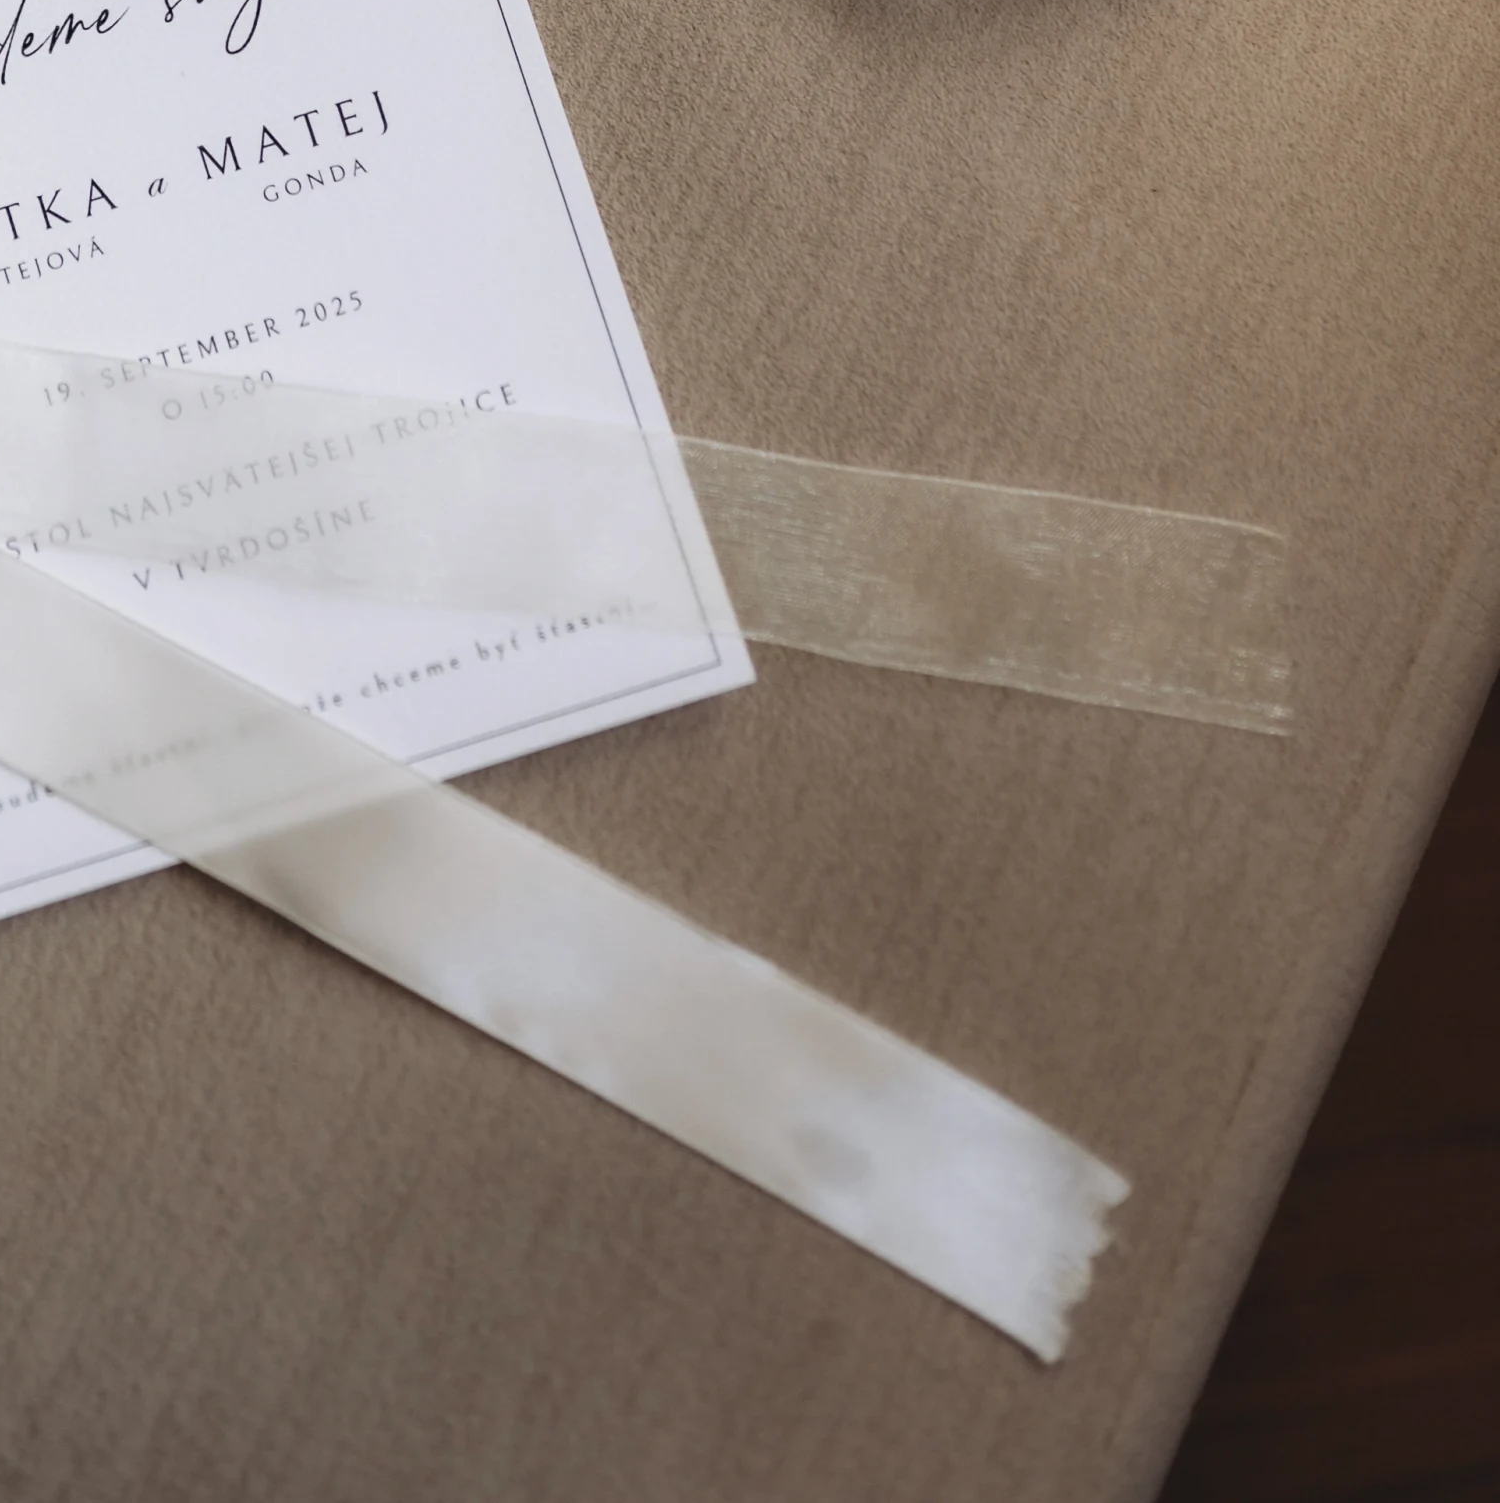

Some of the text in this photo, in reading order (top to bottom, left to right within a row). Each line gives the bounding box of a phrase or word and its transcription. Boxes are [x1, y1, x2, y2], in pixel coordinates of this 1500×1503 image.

[147, 175, 169, 198] a
[196, 90, 390, 182] MATEJ
[262, 158, 369, 203] GONDA
[100, 316, 281, 390] SEPTEMBER
[295, 290, 365, 330] 2025
[161, 369, 275, 421] O 15:00
[132, 568, 151, 591] V
[360, 653, 461, 699] chceme
